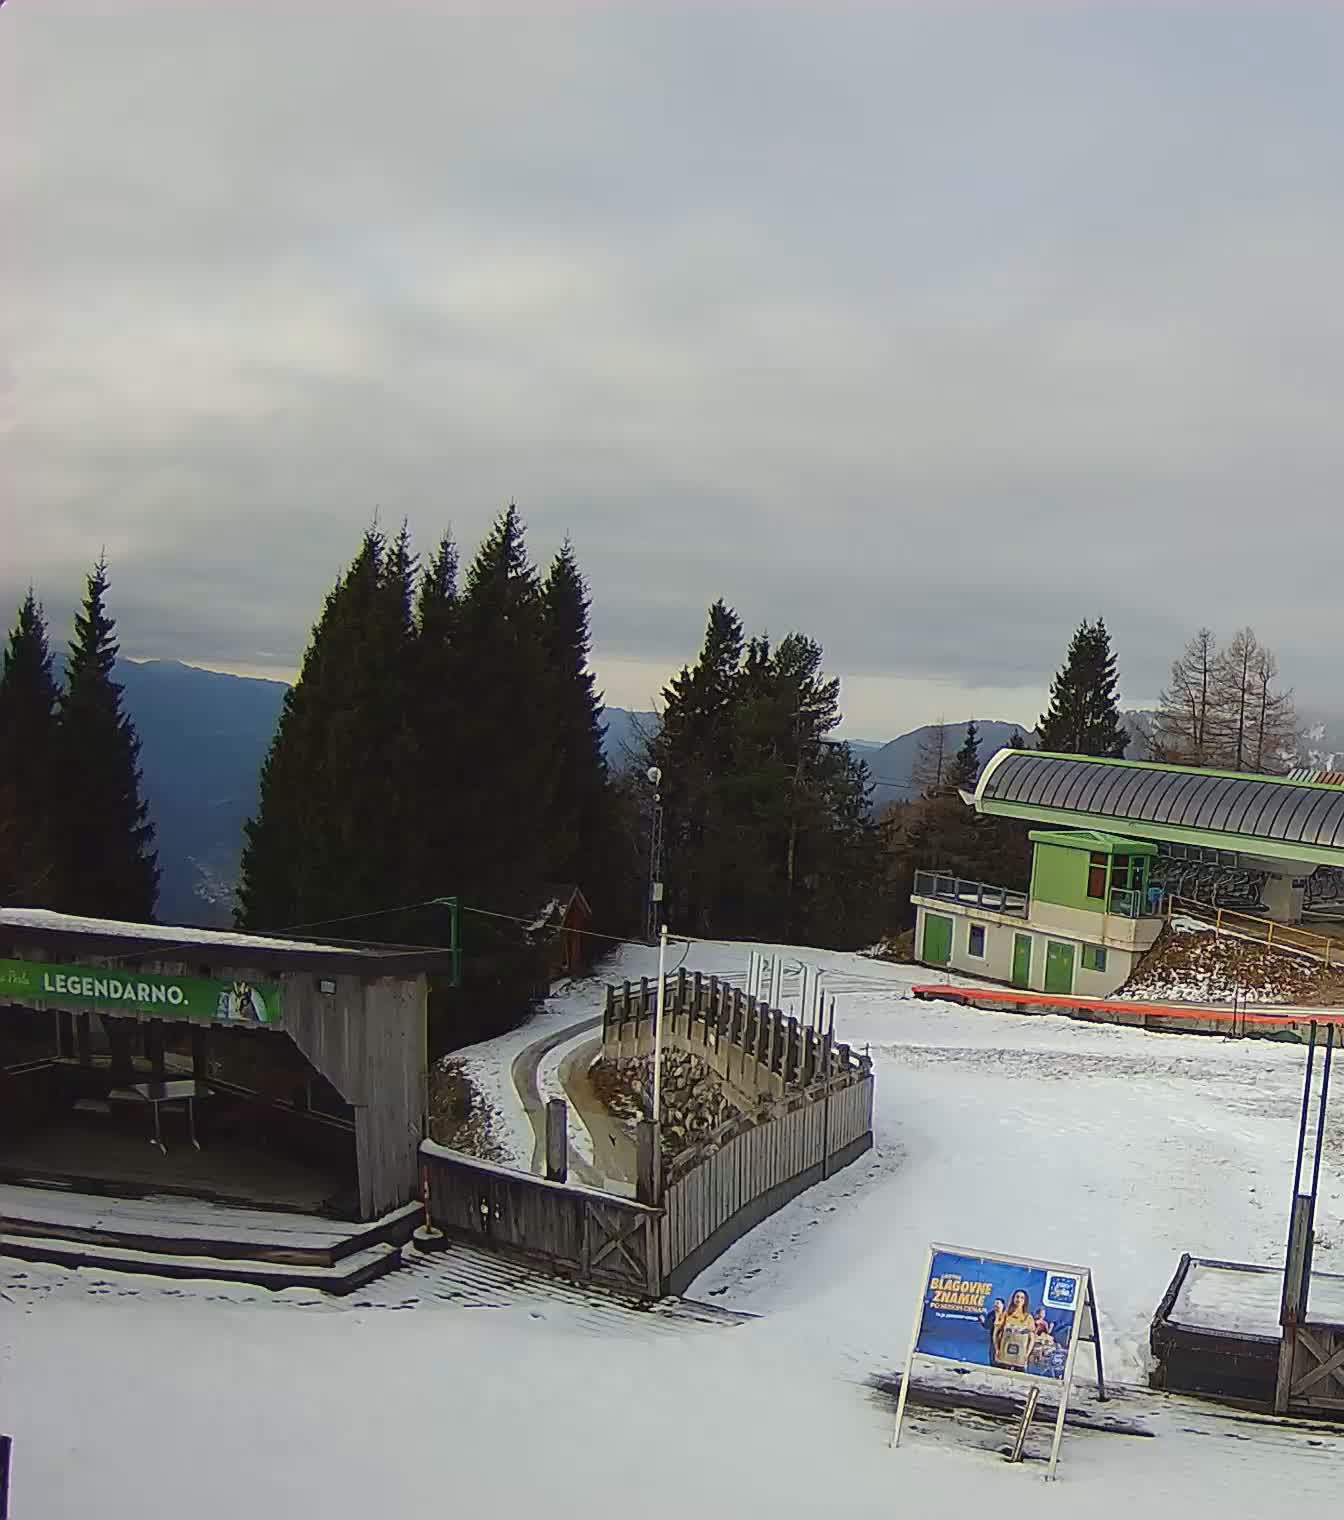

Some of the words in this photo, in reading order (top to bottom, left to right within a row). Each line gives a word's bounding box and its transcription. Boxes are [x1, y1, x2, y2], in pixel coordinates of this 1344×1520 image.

[43, 972, 189, 1005] LEGENDARNO.
[931, 1278, 992, 1295] BLAGOVNE
[933, 1291, 985, 1306] ZNAMKE
